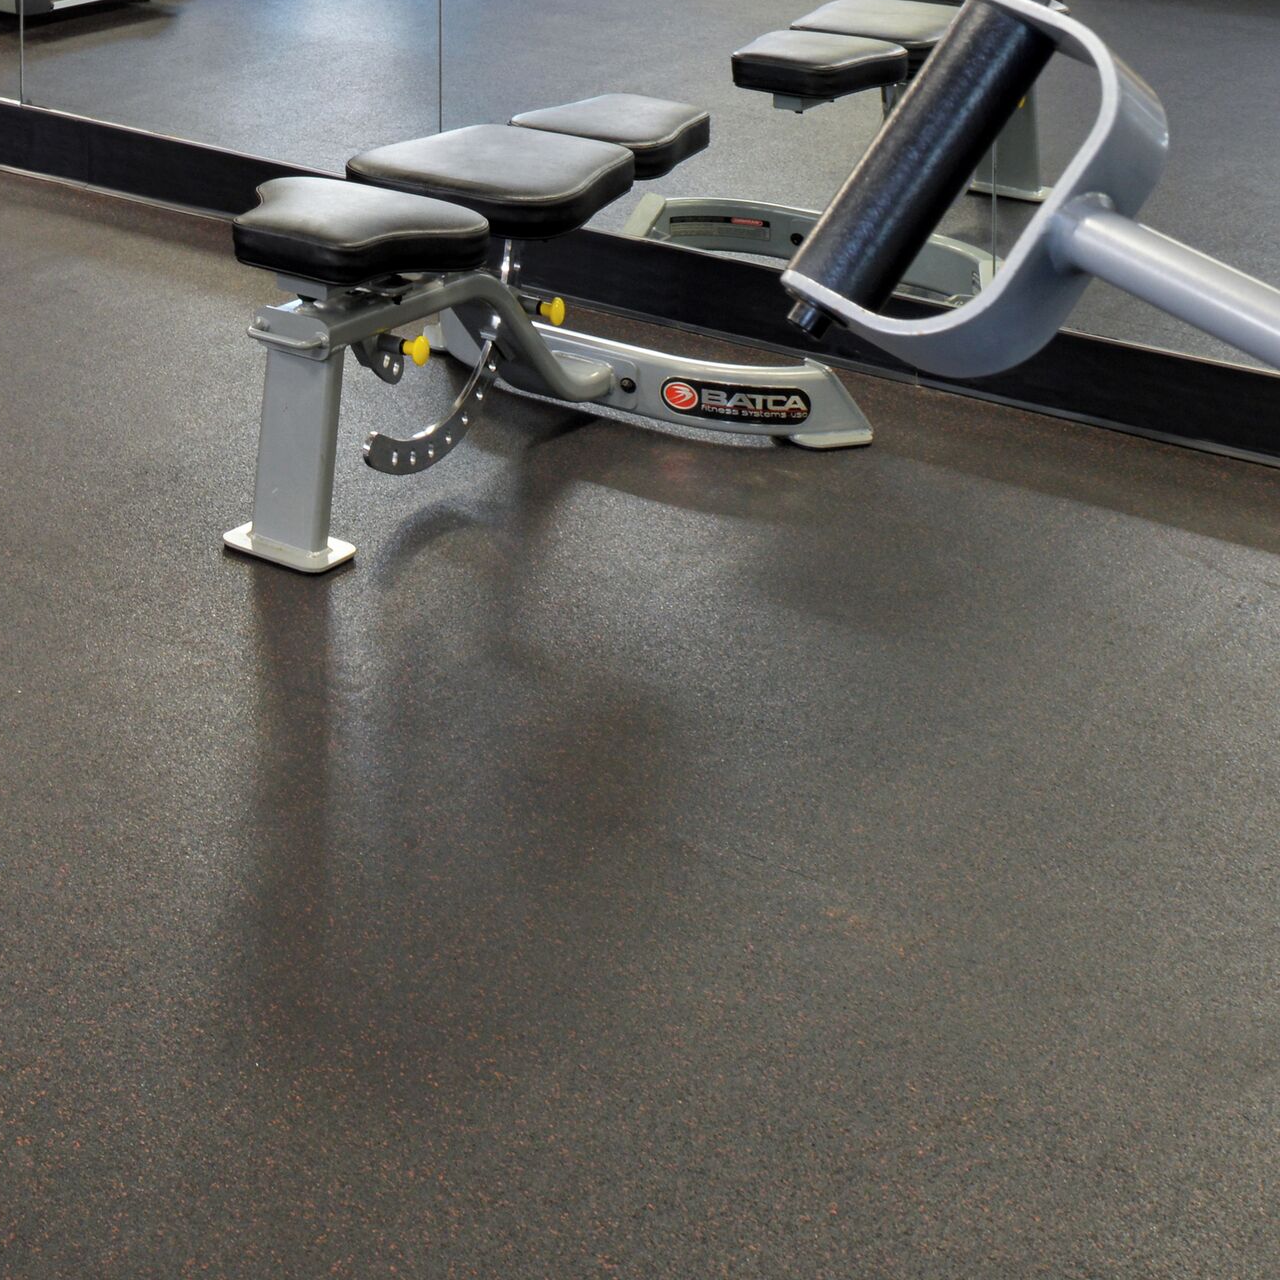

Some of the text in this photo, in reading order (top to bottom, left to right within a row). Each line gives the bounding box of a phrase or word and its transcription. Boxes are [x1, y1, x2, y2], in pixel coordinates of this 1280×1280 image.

[701, 389, 809, 410] BATCA
[701, 404, 739, 416] fitness
[741, 410, 787, 418] systems
